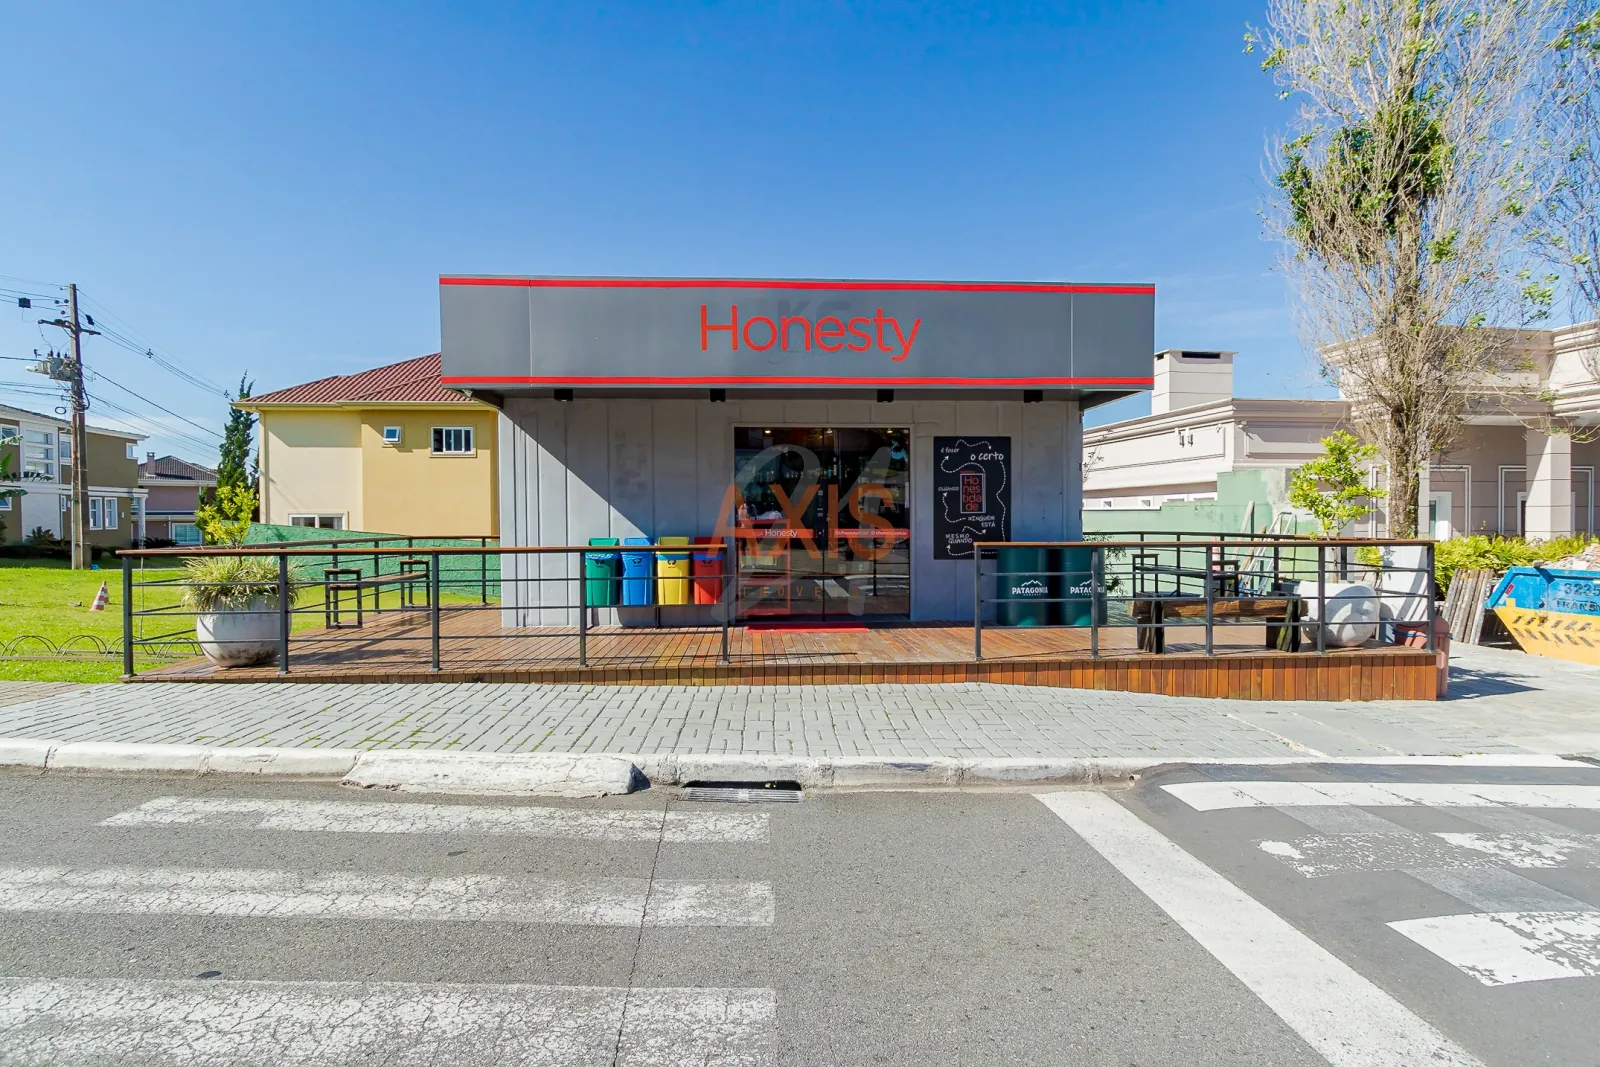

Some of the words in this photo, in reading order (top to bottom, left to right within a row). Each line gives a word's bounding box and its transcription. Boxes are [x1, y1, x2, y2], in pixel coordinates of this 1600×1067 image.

[700, 304, 922, 362] Honesty
[978, 452, 1004, 460] certo
[765, 529, 798, 538] Honesty
